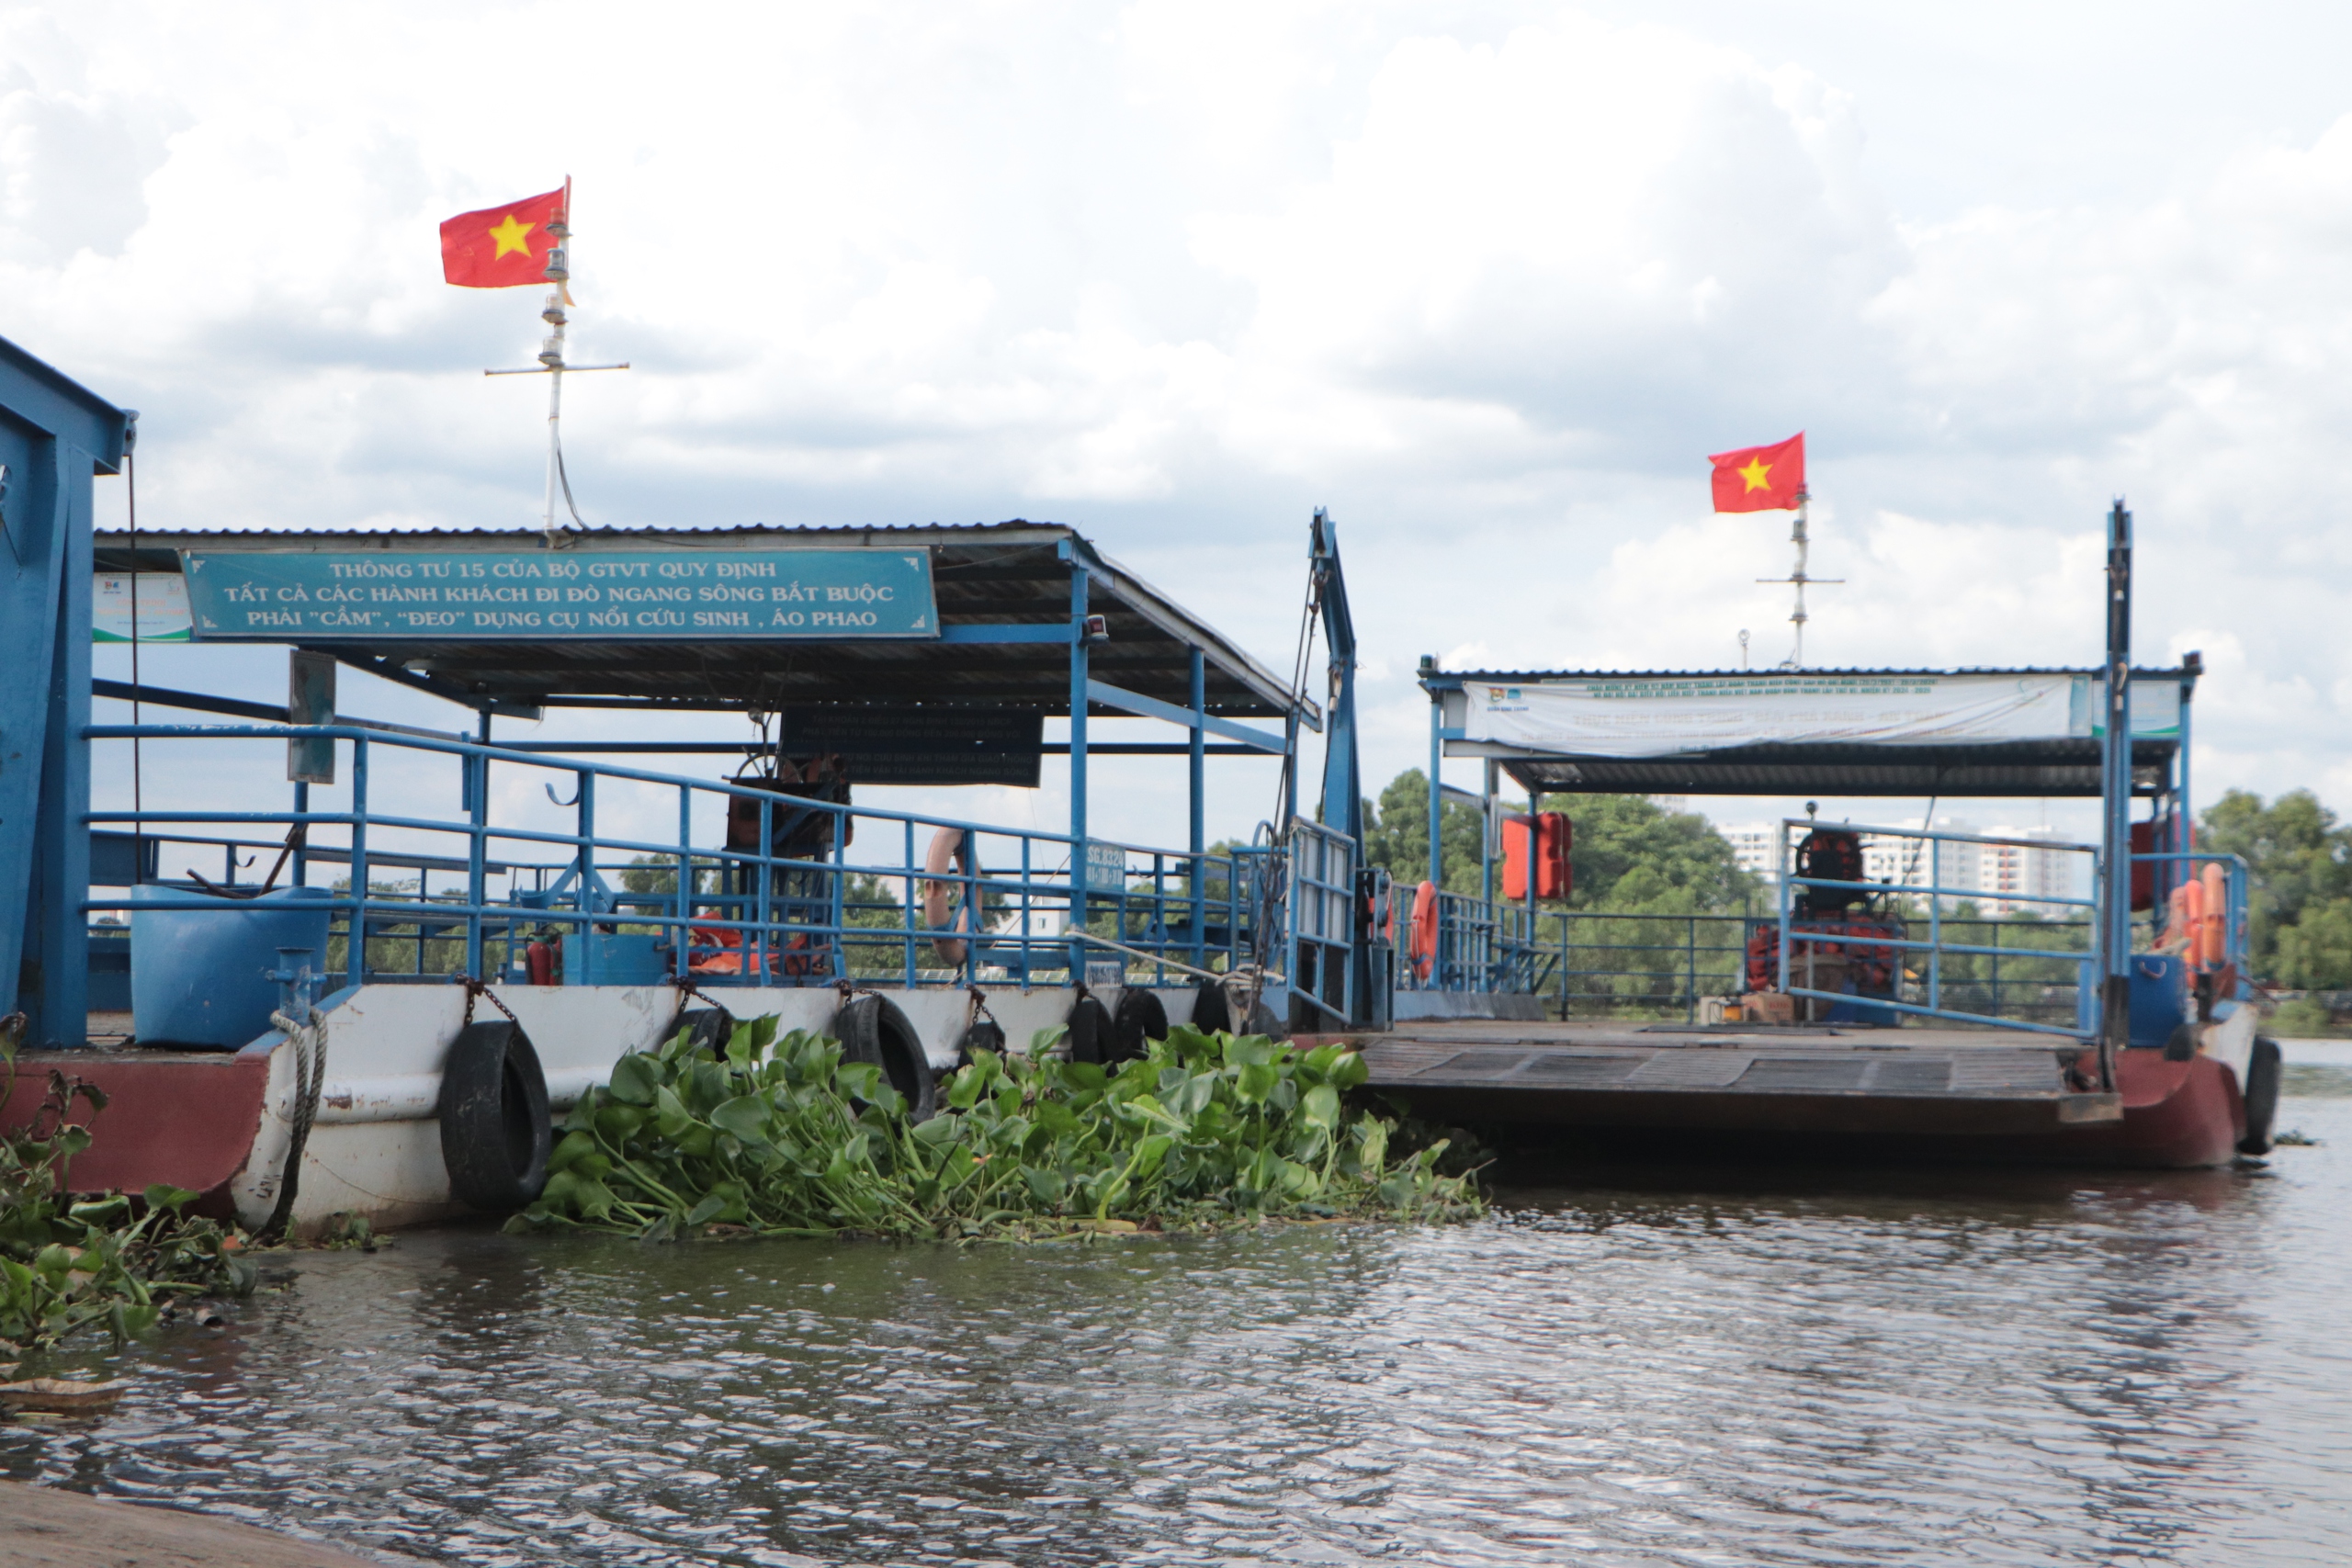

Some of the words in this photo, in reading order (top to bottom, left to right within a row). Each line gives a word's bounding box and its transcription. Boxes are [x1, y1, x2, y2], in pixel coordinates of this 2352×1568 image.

[329, 559, 413, 578] THÔNG
[459, 563, 485, 578] 15
[492, 559, 542, 578] CỦA
[548, 559, 581, 581] BỘ
[588, 562, 650, 578] GTVT
[658, 562, 708, 579] QUY
[717, 562, 776, 581] ĐỊNH
[223, 581, 269, 602] TẤT
[277, 582, 310, 602] CẢ
[315, 583, 364, 602] CÁC
[370, 583, 438, 602] HÀNH
[445, 583, 529, 602] KHÁCH
[535, 587, 560, 602] ĐI
[566, 583, 601, 602] ĐÒ
[607, 586, 692, 602] NGANG
[698, 582, 765, 602] SÔNG
[771, 580, 820, 602] BẮT
[826, 582, 894, 604] BUỘC
[247, 607, 302, 626] PHẢI
[473, 611, 542, 629] DỤNG
[548, 612, 580, 629] CỤ
[636, 607, 685, 626] CỨU
[693, 611, 750, 626] SINH
[771, 607, 805, 626] ÁO
[811, 611, 878, 626] PHAO
